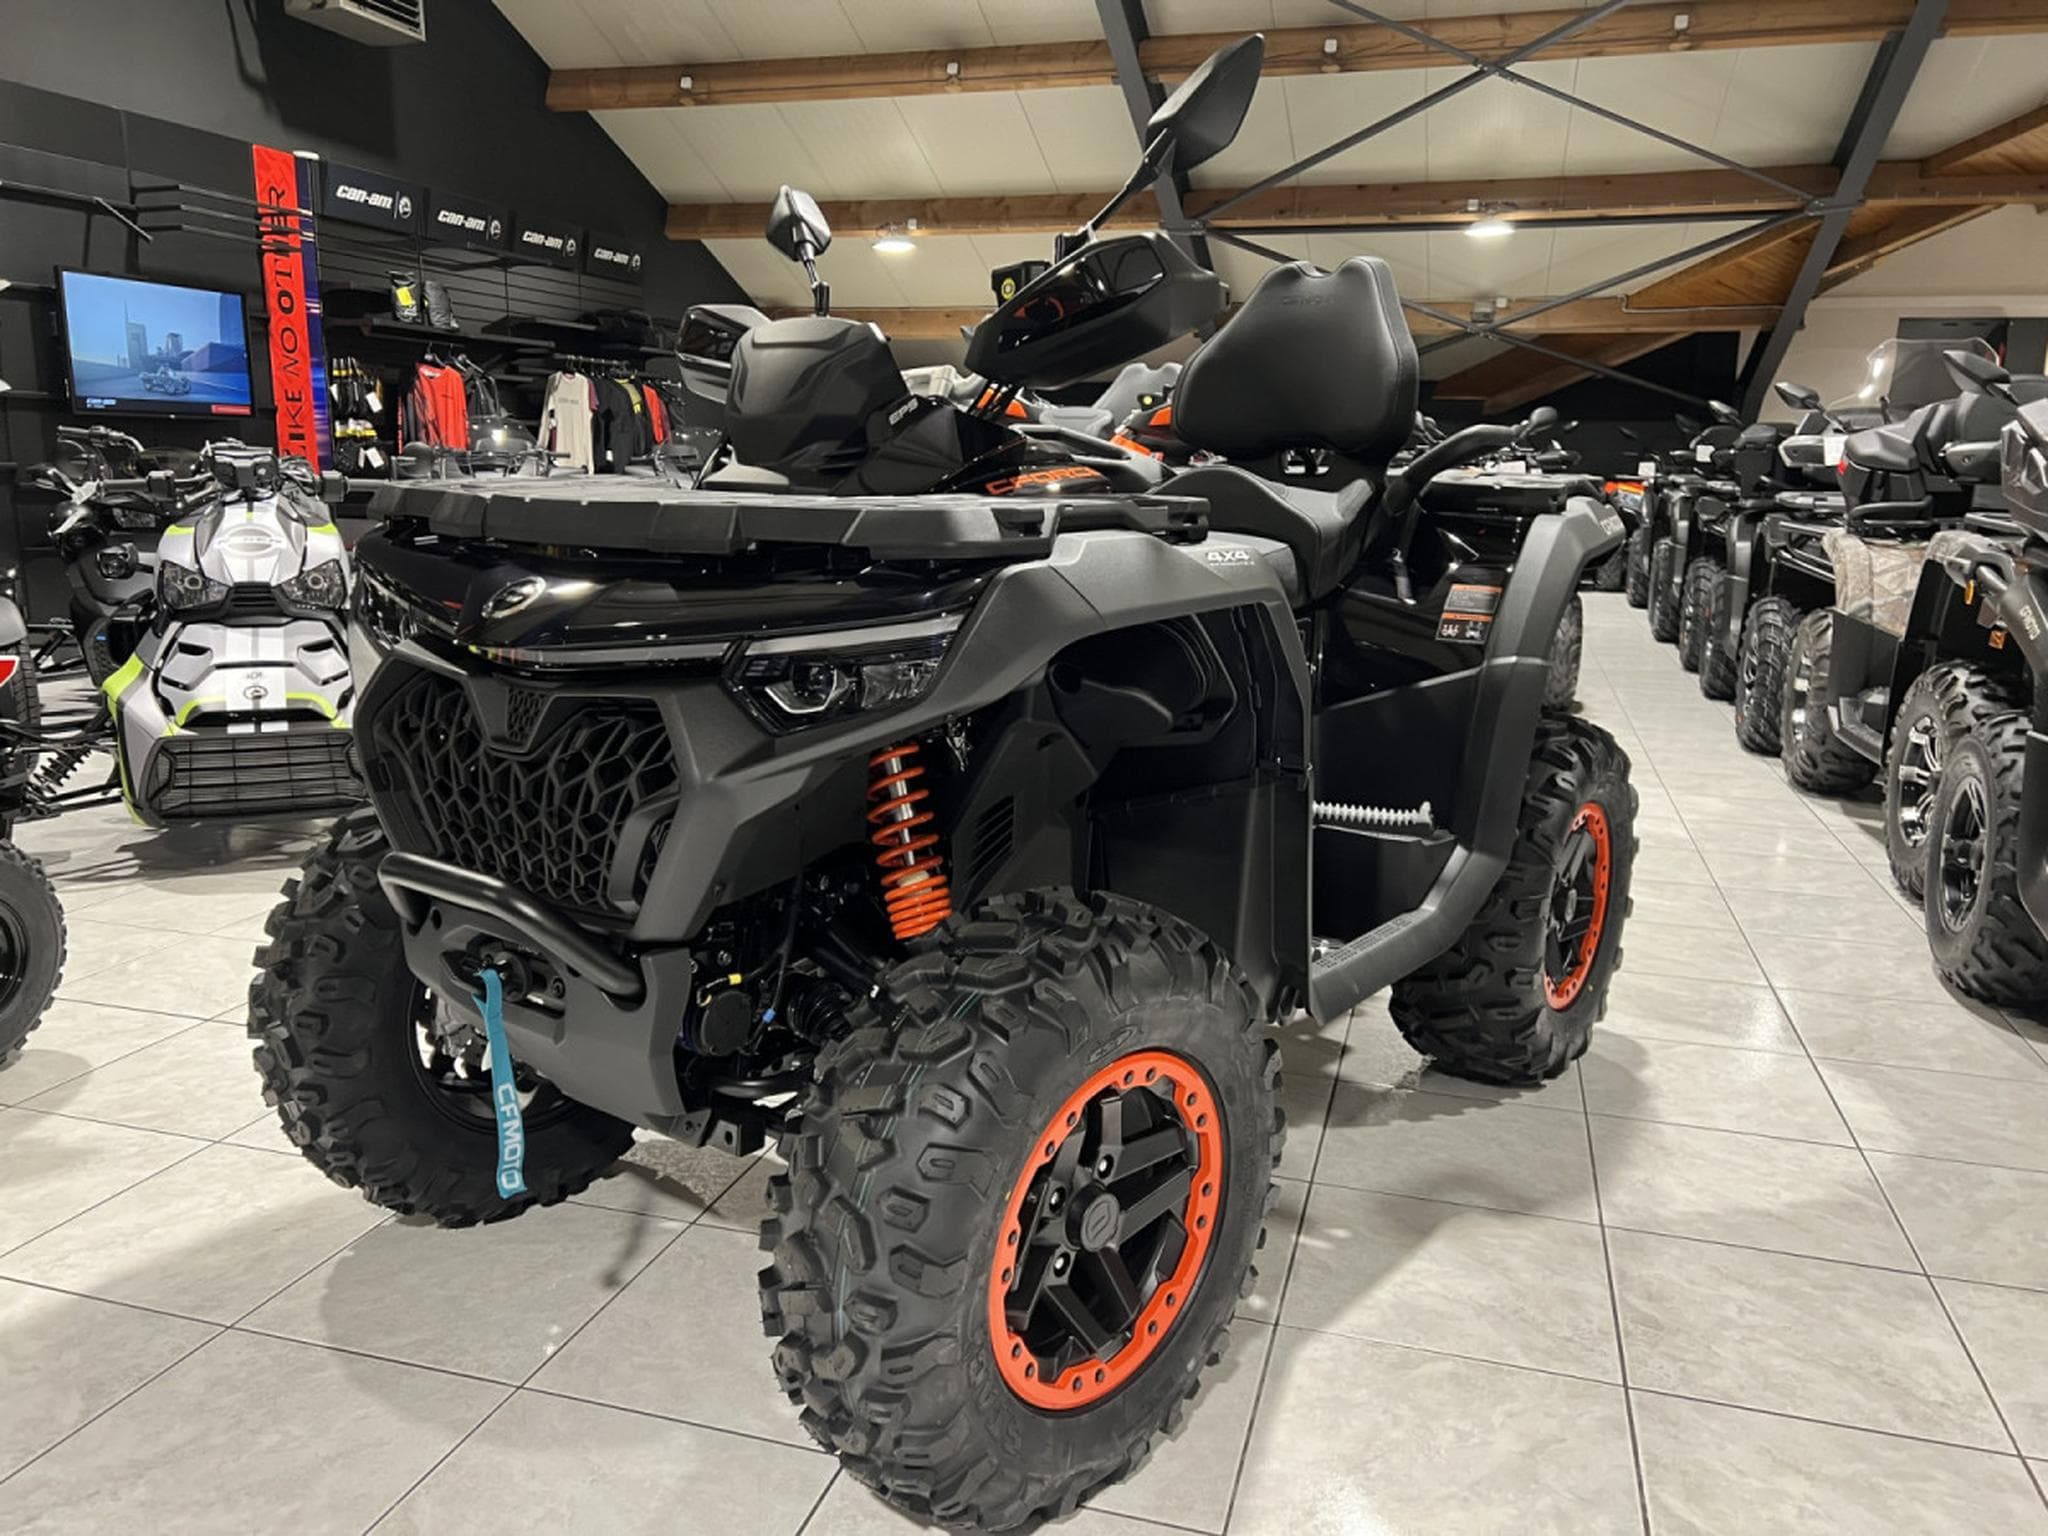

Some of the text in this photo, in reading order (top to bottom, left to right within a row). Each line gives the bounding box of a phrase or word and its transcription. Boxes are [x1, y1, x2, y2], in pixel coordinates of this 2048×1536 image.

[269, 185, 295, 314] OTER
[280, 326, 299, 377] NO
[889, 397, 919, 426] EPS
[497, 1083, 523, 1190] CFMOTO
